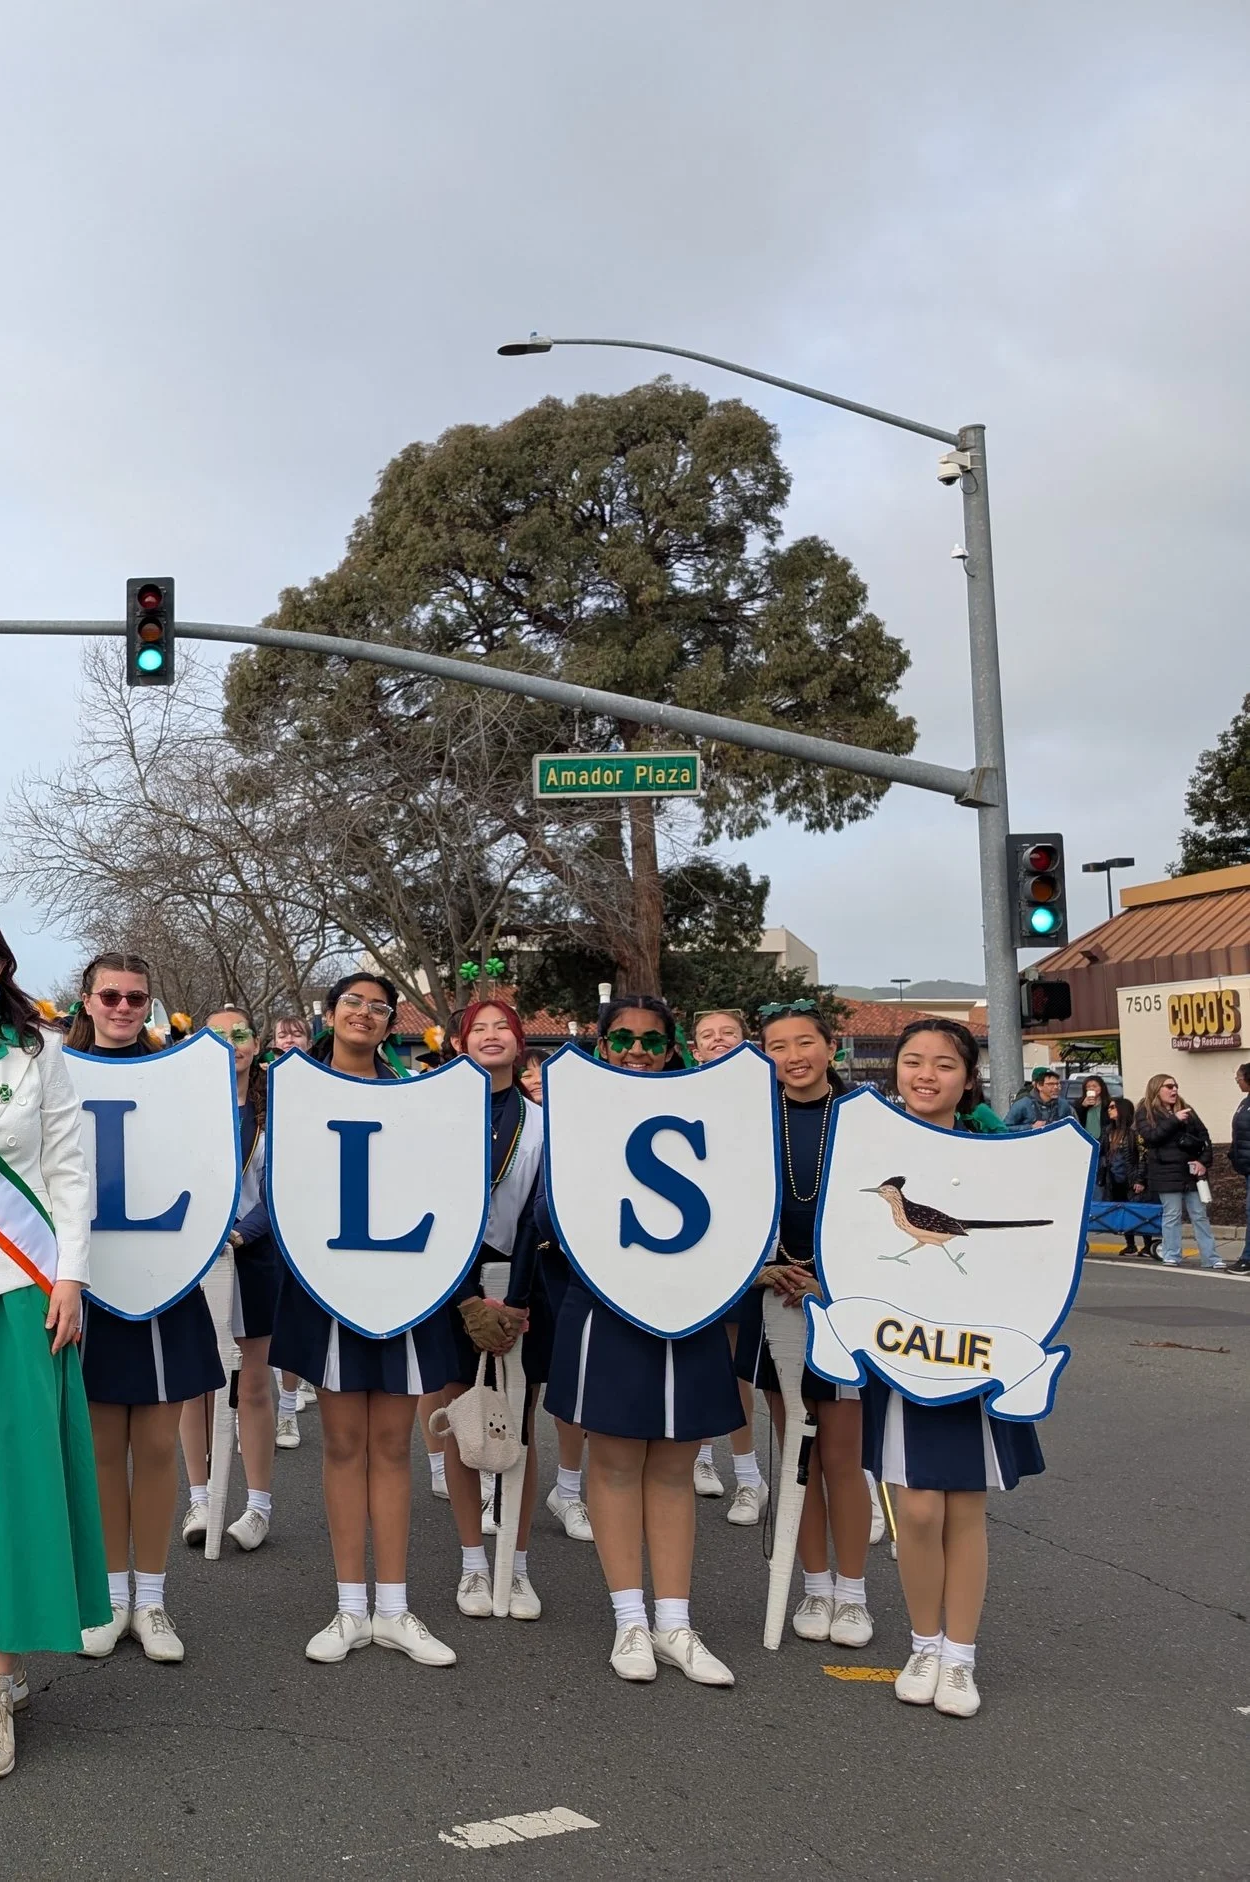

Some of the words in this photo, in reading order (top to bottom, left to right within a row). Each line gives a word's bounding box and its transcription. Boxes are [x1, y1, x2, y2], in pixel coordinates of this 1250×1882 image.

[546, 767, 623, 786] Amador
[636, 765, 691, 784] Plaza
[1126, 994, 1162, 1013] 7505
[1168, 989, 1238, 1036] COCO'S
[1172, 1038, 1193, 1049] Bakery
[1201, 1037, 1235, 1047] Restaurant
[81, 1099, 192, 1231] L
[326, 1119, 435, 1253] L
[619, 1115, 711, 1254] S
[874, 1317, 992, 1373] CALIF.
